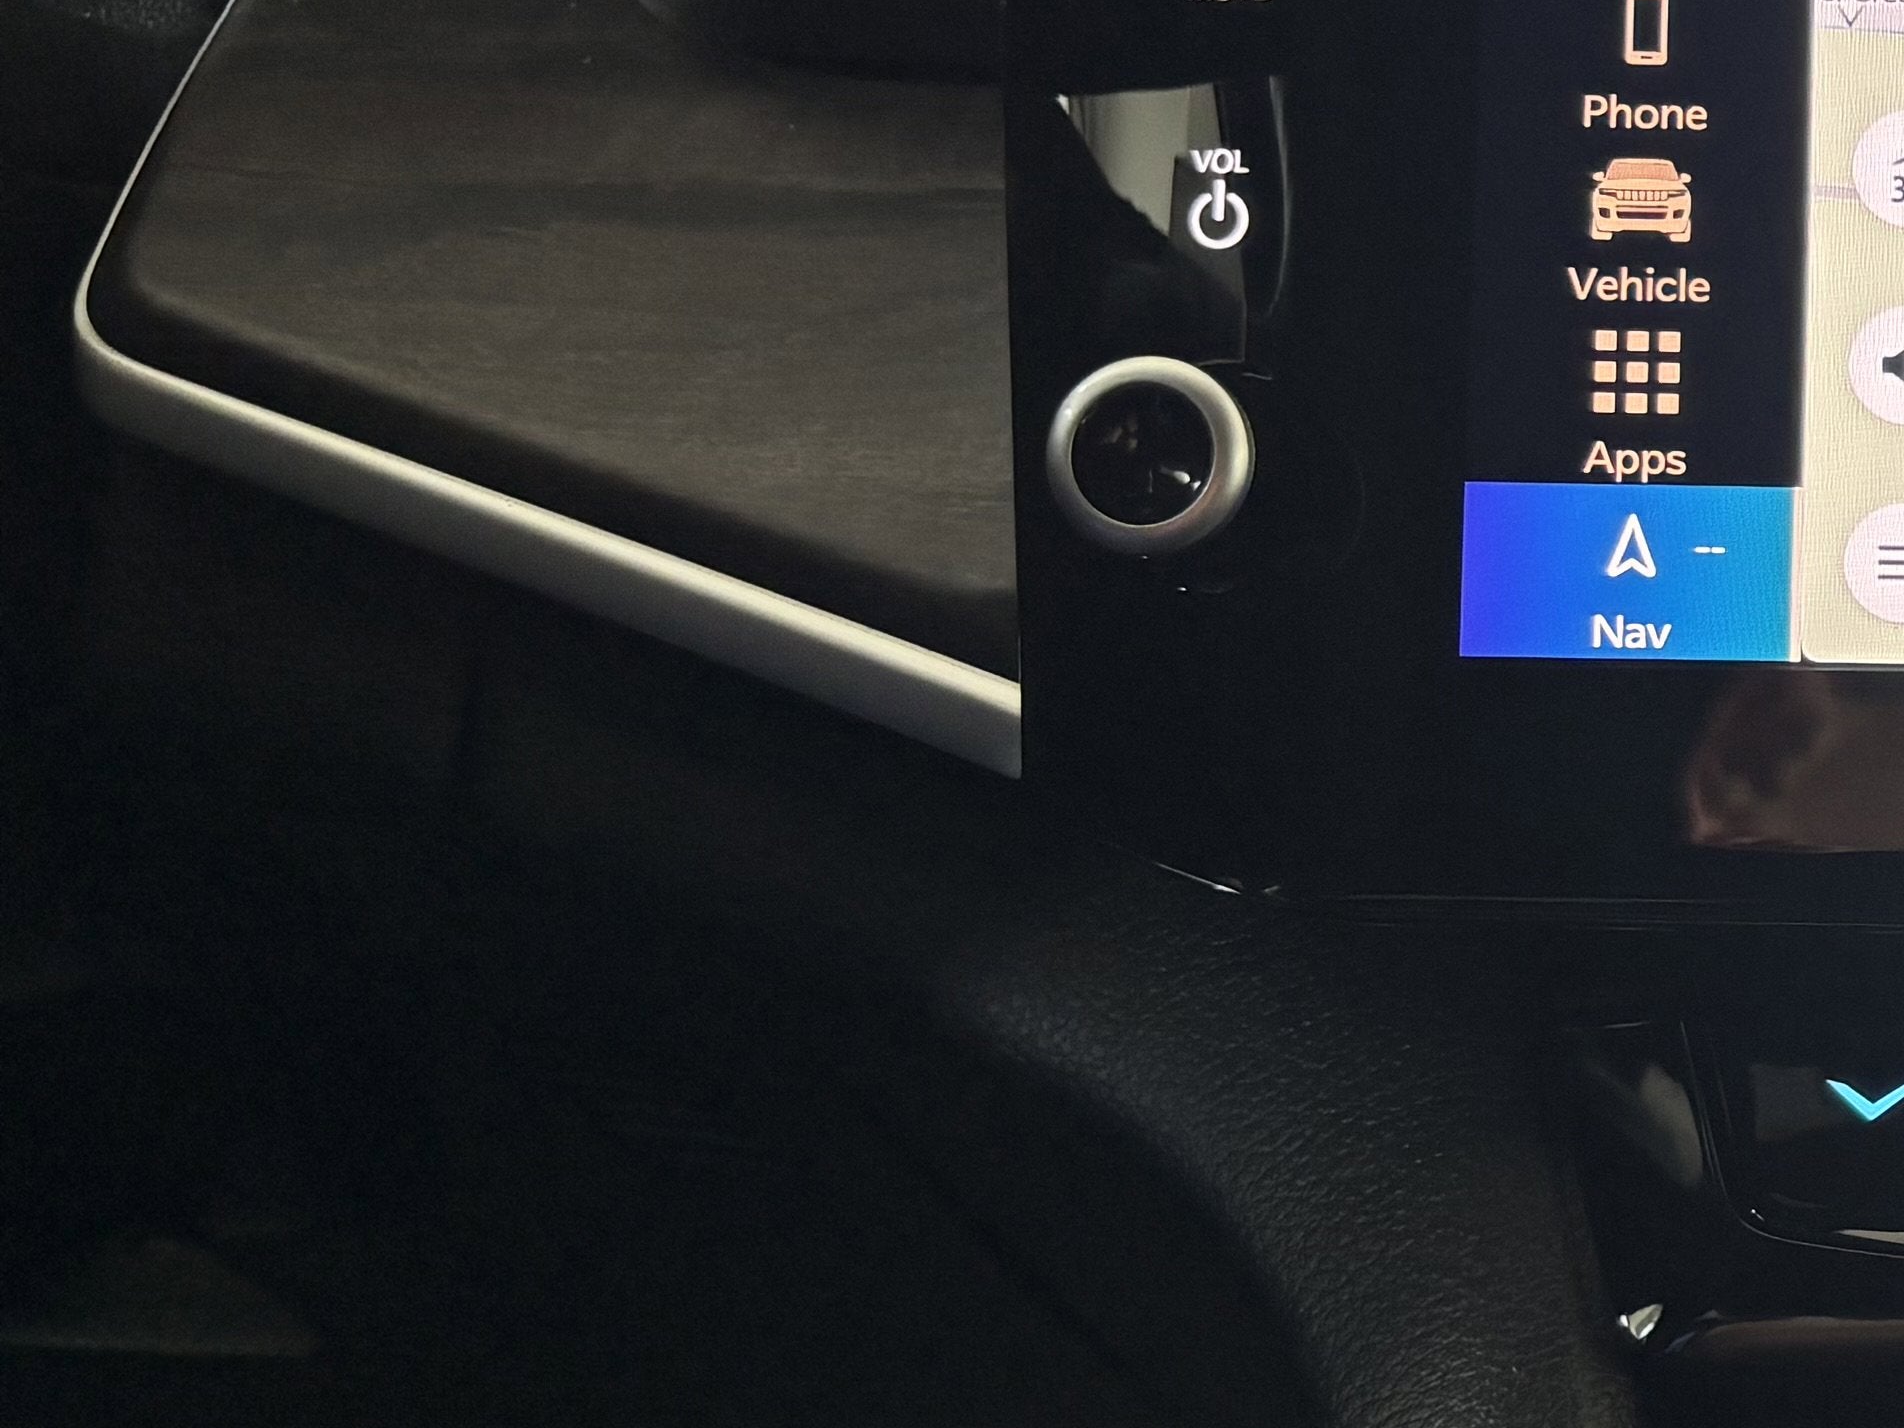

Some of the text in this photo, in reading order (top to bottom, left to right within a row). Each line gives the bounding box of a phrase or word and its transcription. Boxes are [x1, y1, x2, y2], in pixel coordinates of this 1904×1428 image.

[1582, 94, 1709, 132] Phone
[1190, 148, 1250, 175] VOL
[1567, 266, 1711, 305] Vehicle
[1582, 441, 1688, 483] Apps
[1591, 614, 1673, 651] Nav
